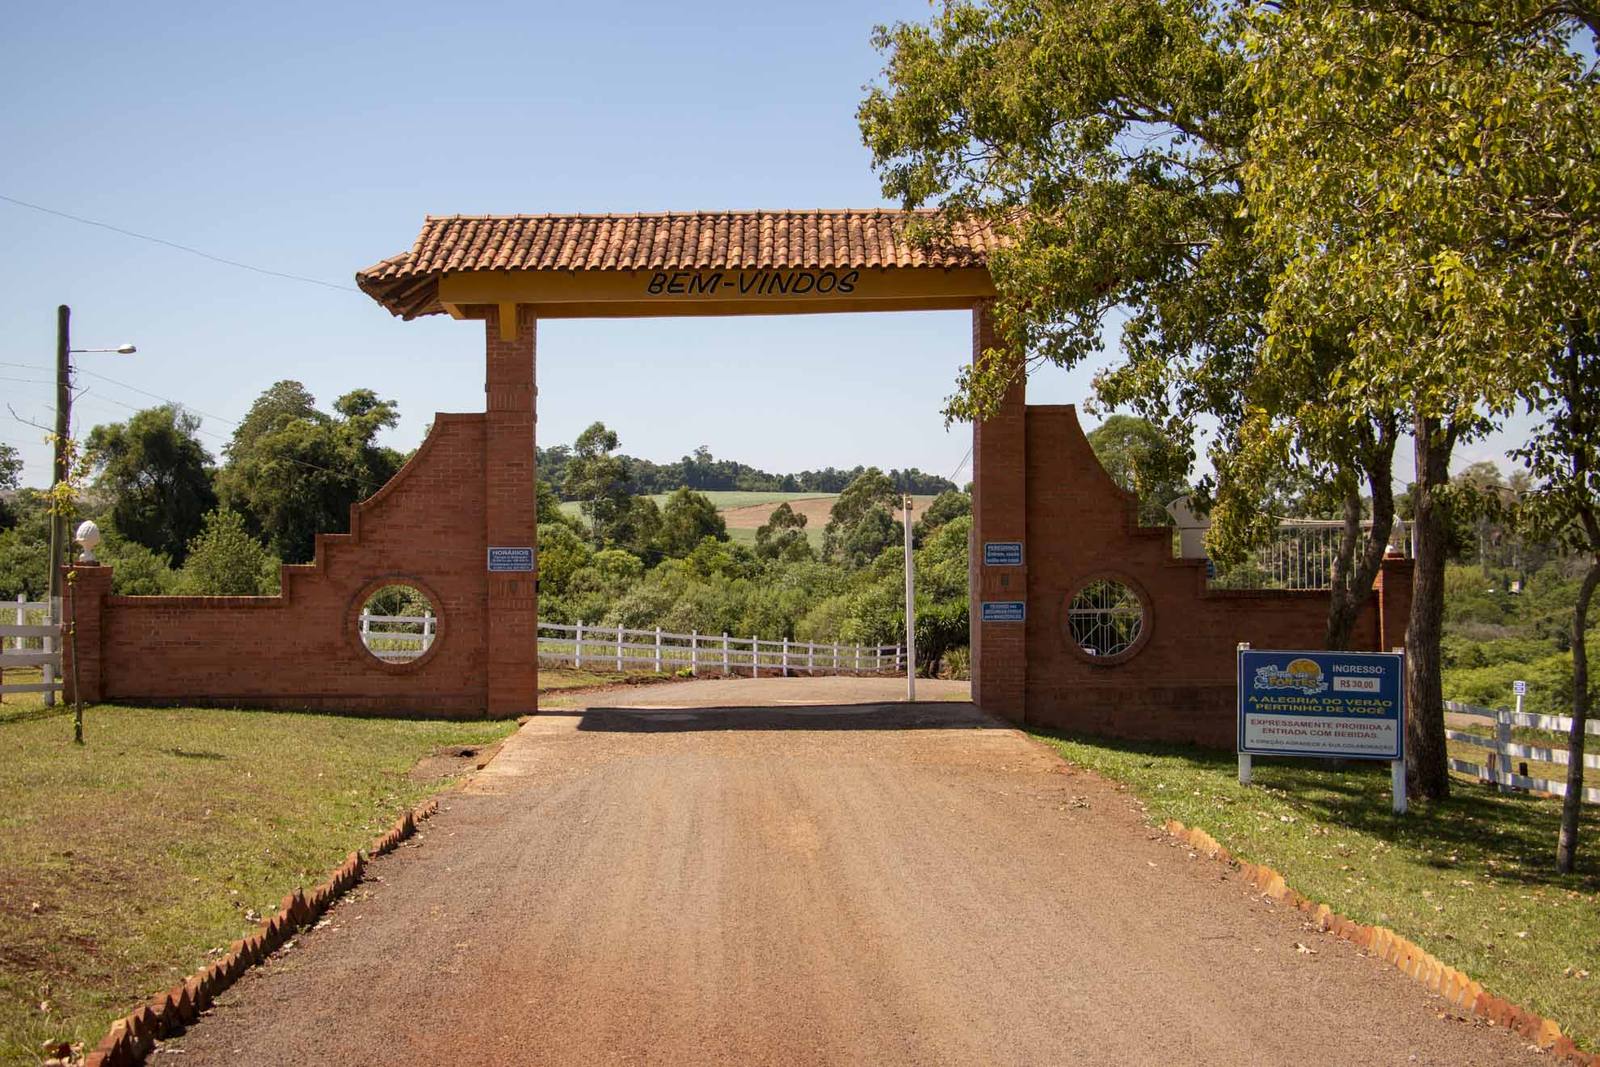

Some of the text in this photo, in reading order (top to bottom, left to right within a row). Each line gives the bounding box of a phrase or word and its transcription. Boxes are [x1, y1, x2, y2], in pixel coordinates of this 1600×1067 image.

[648, 271, 859, 295] BEM-VINDOS
[1332, 664, 1386, 674] INGRESSO:
[1340, 680, 1350, 688] R$
[1261, 696, 1319, 705] ALEGRIA
[1345, 697, 1393, 707] VERÃO
[1255, 703, 1386, 715] PERTINHO DE VOCÊ
[1250, 719, 1333, 729] EXPRESSAMENTE
[1335, 722, 1382, 731] PROIBIDA
[1262, 727, 1308, 736] ENTRADA
[1309, 729, 1332, 737] COM
